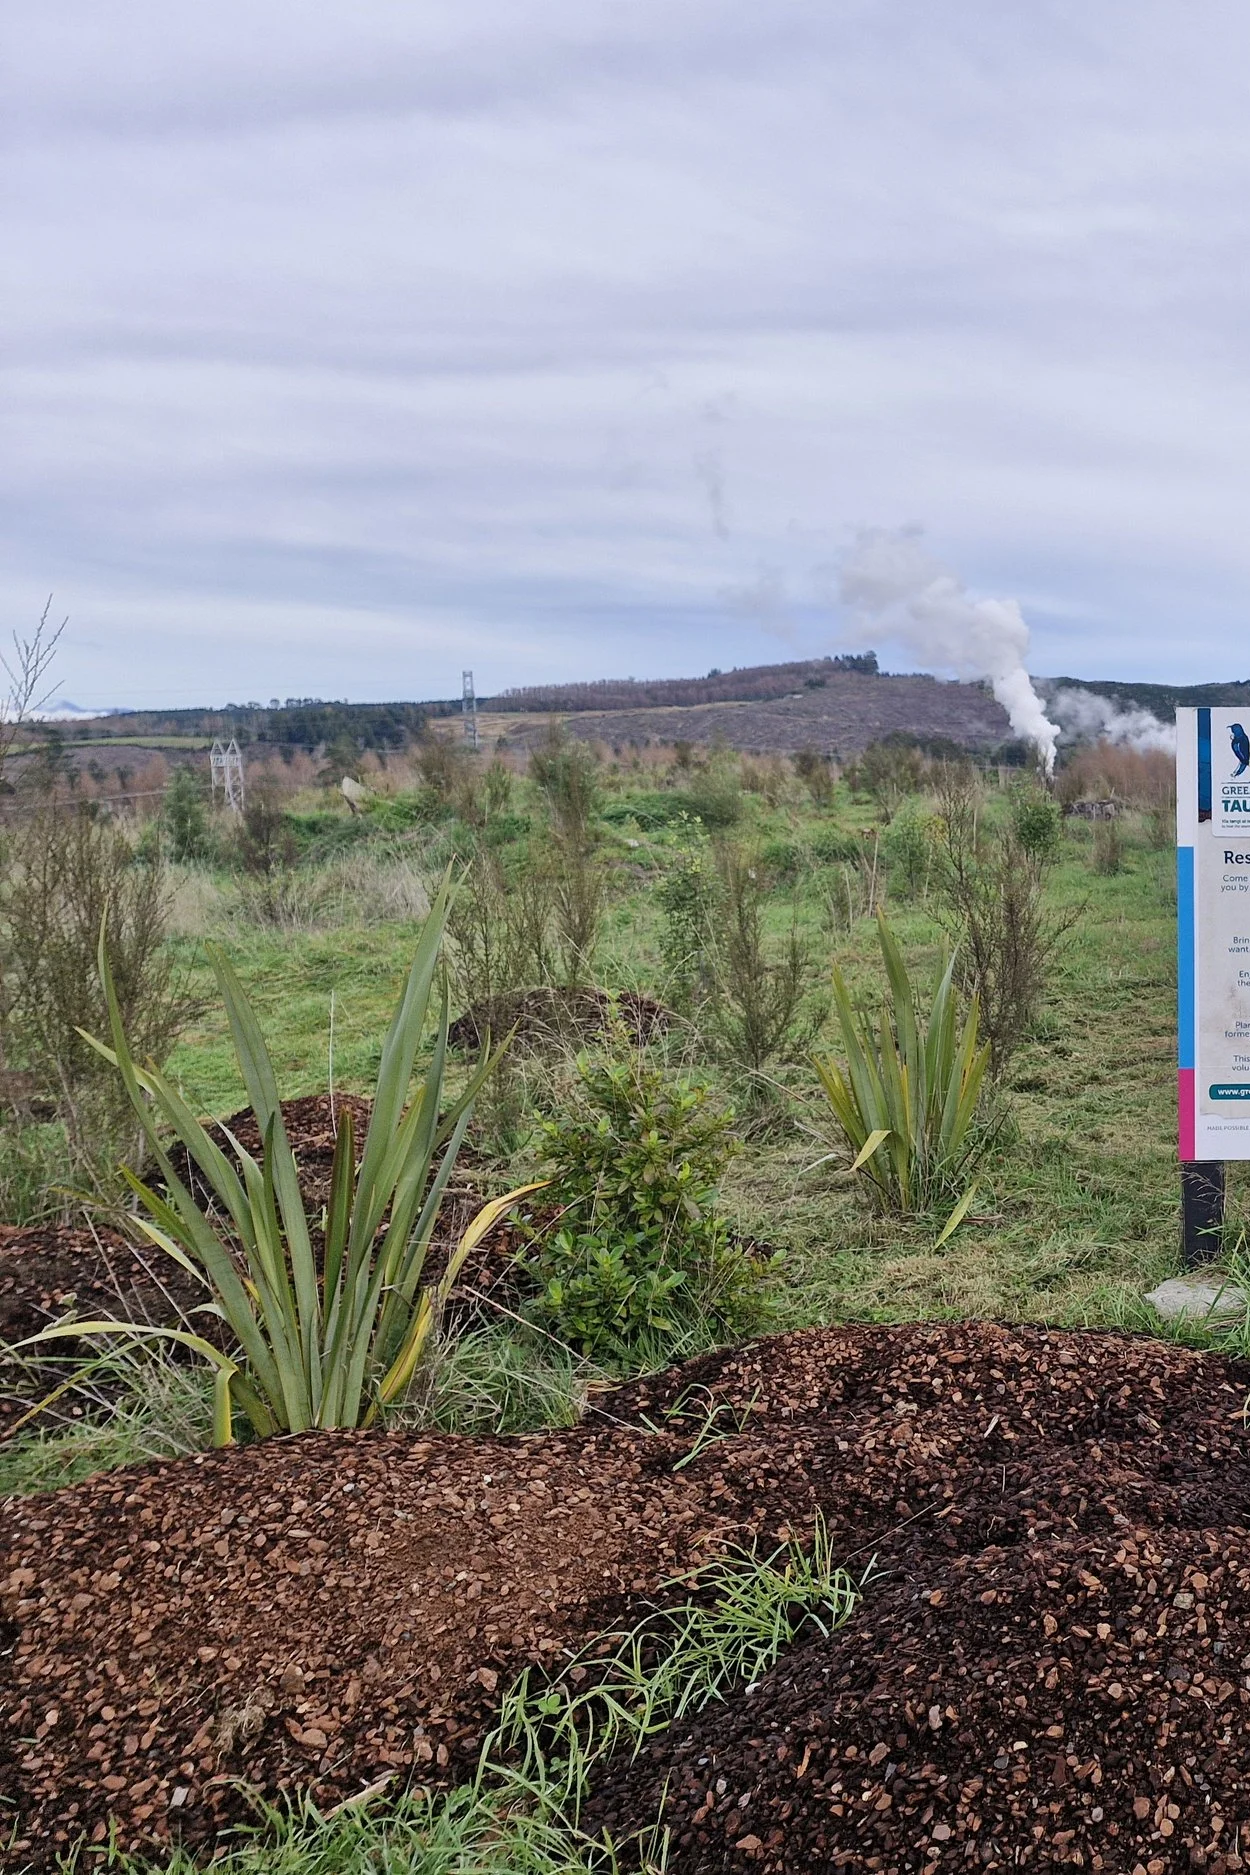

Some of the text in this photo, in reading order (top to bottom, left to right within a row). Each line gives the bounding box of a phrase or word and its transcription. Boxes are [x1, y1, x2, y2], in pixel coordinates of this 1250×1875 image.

[1222, 874, 1248, 882] Come
[1239, 883, 1249, 892] by
[1233, 1054, 1250, 1062] This
